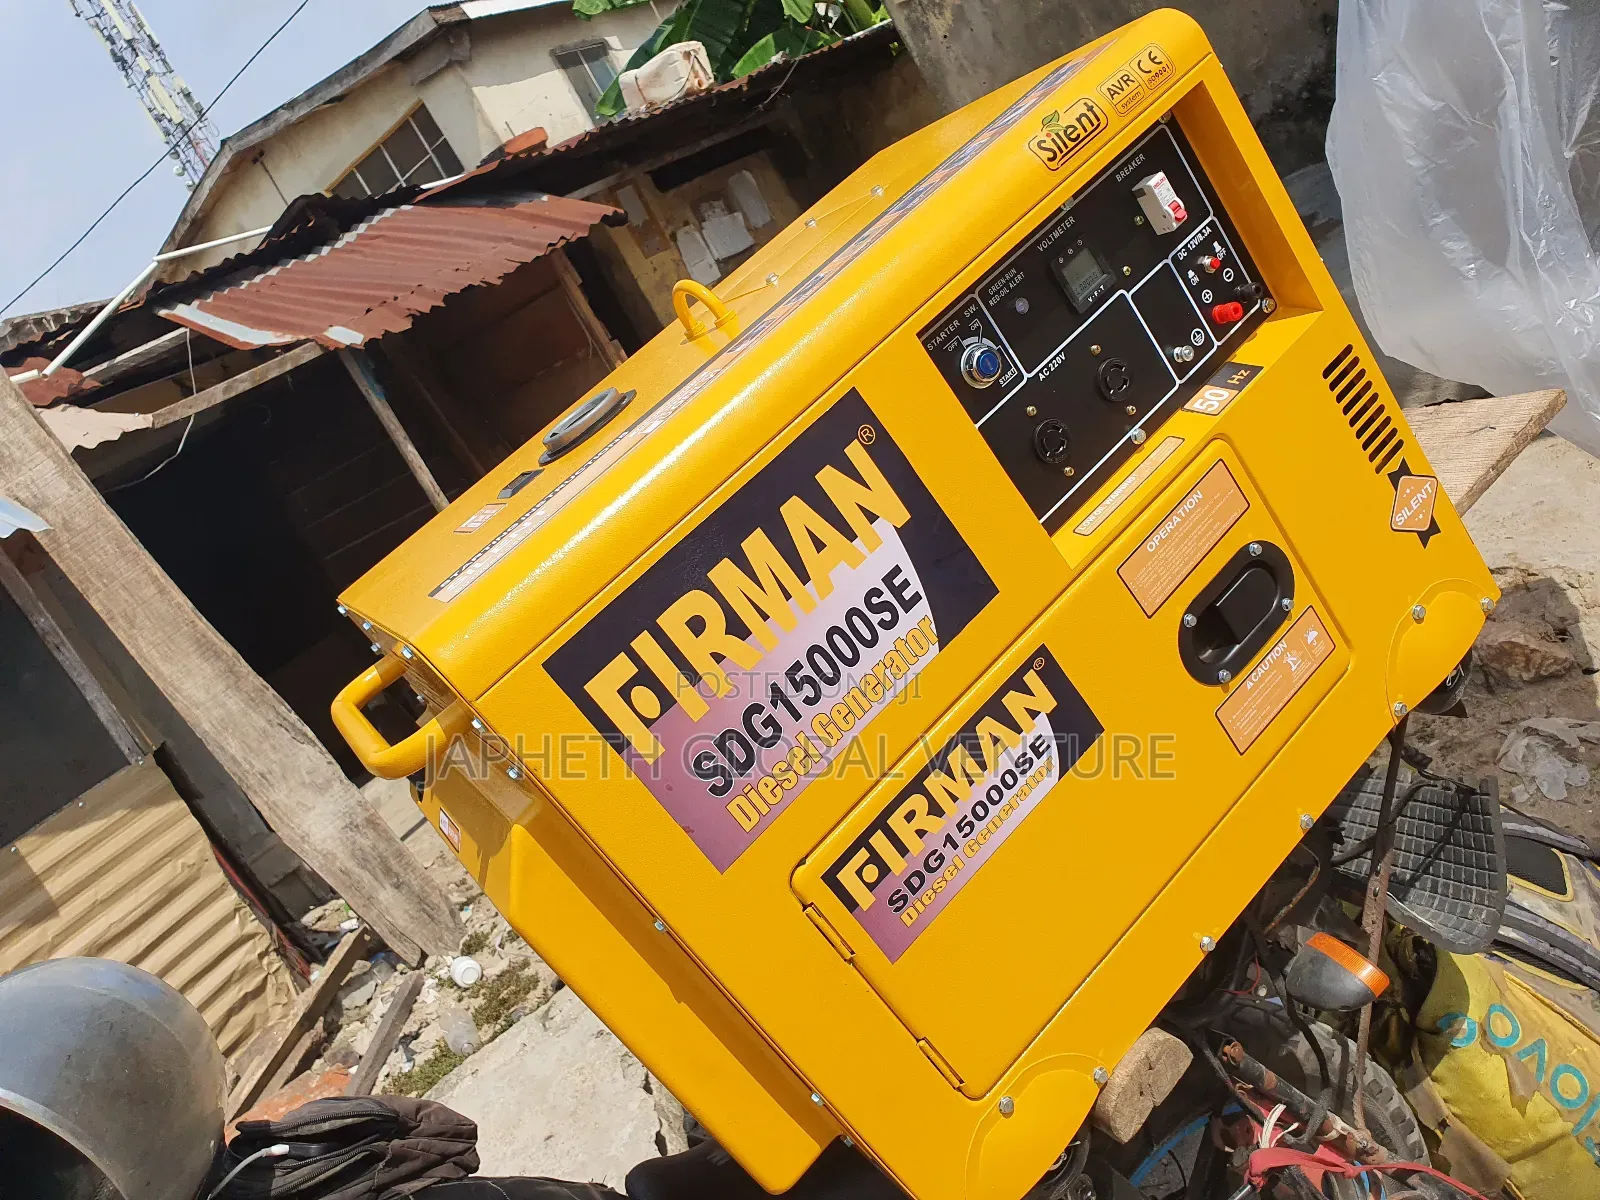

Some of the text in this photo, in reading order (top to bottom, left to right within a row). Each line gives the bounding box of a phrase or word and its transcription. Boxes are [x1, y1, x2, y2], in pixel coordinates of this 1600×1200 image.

[1106, 73, 1136, 100] AVR
[1121, 91, 1142, 109] system
[1036, 102, 1101, 163] Silent
[1115, 153, 1146, 182] BREAKER
[1036, 216, 1076, 252] VOLTMETER
[1176, 249, 1188, 261] DC
[1216, 247, 1227, 261] OFF
[988, 267, 1017, 296] GREEN-RUN
[988, 271, 1025, 307] RED-OIL ALERT
[1190, 275, 1200, 286] ON
[927, 304, 979, 352] STARTER SW.
[970, 321, 979, 331] ON
[947, 341, 959, 352] OFF
[999, 368, 1016, 385] START
[1038, 352, 1067, 382] AC 220V
[1227, 369, 1251, 385] Hz
[1193, 389, 1230, 412] 50
[1395, 481, 1432, 526] SILENT
[1146, 490, 1204, 553] OPERATION
[583, 438, 911, 766] FIRMAN
[1250, 640, 1288, 683] CAUTION
[692, 564, 922, 797] SDG15000SE
[725, 613, 939, 834] Diesel Generator
[836, 669, 1058, 912] FIRMAN
[887, 733, 1052, 914] SDG15000SE
[900, 755, 1055, 928] Diesel Generator
